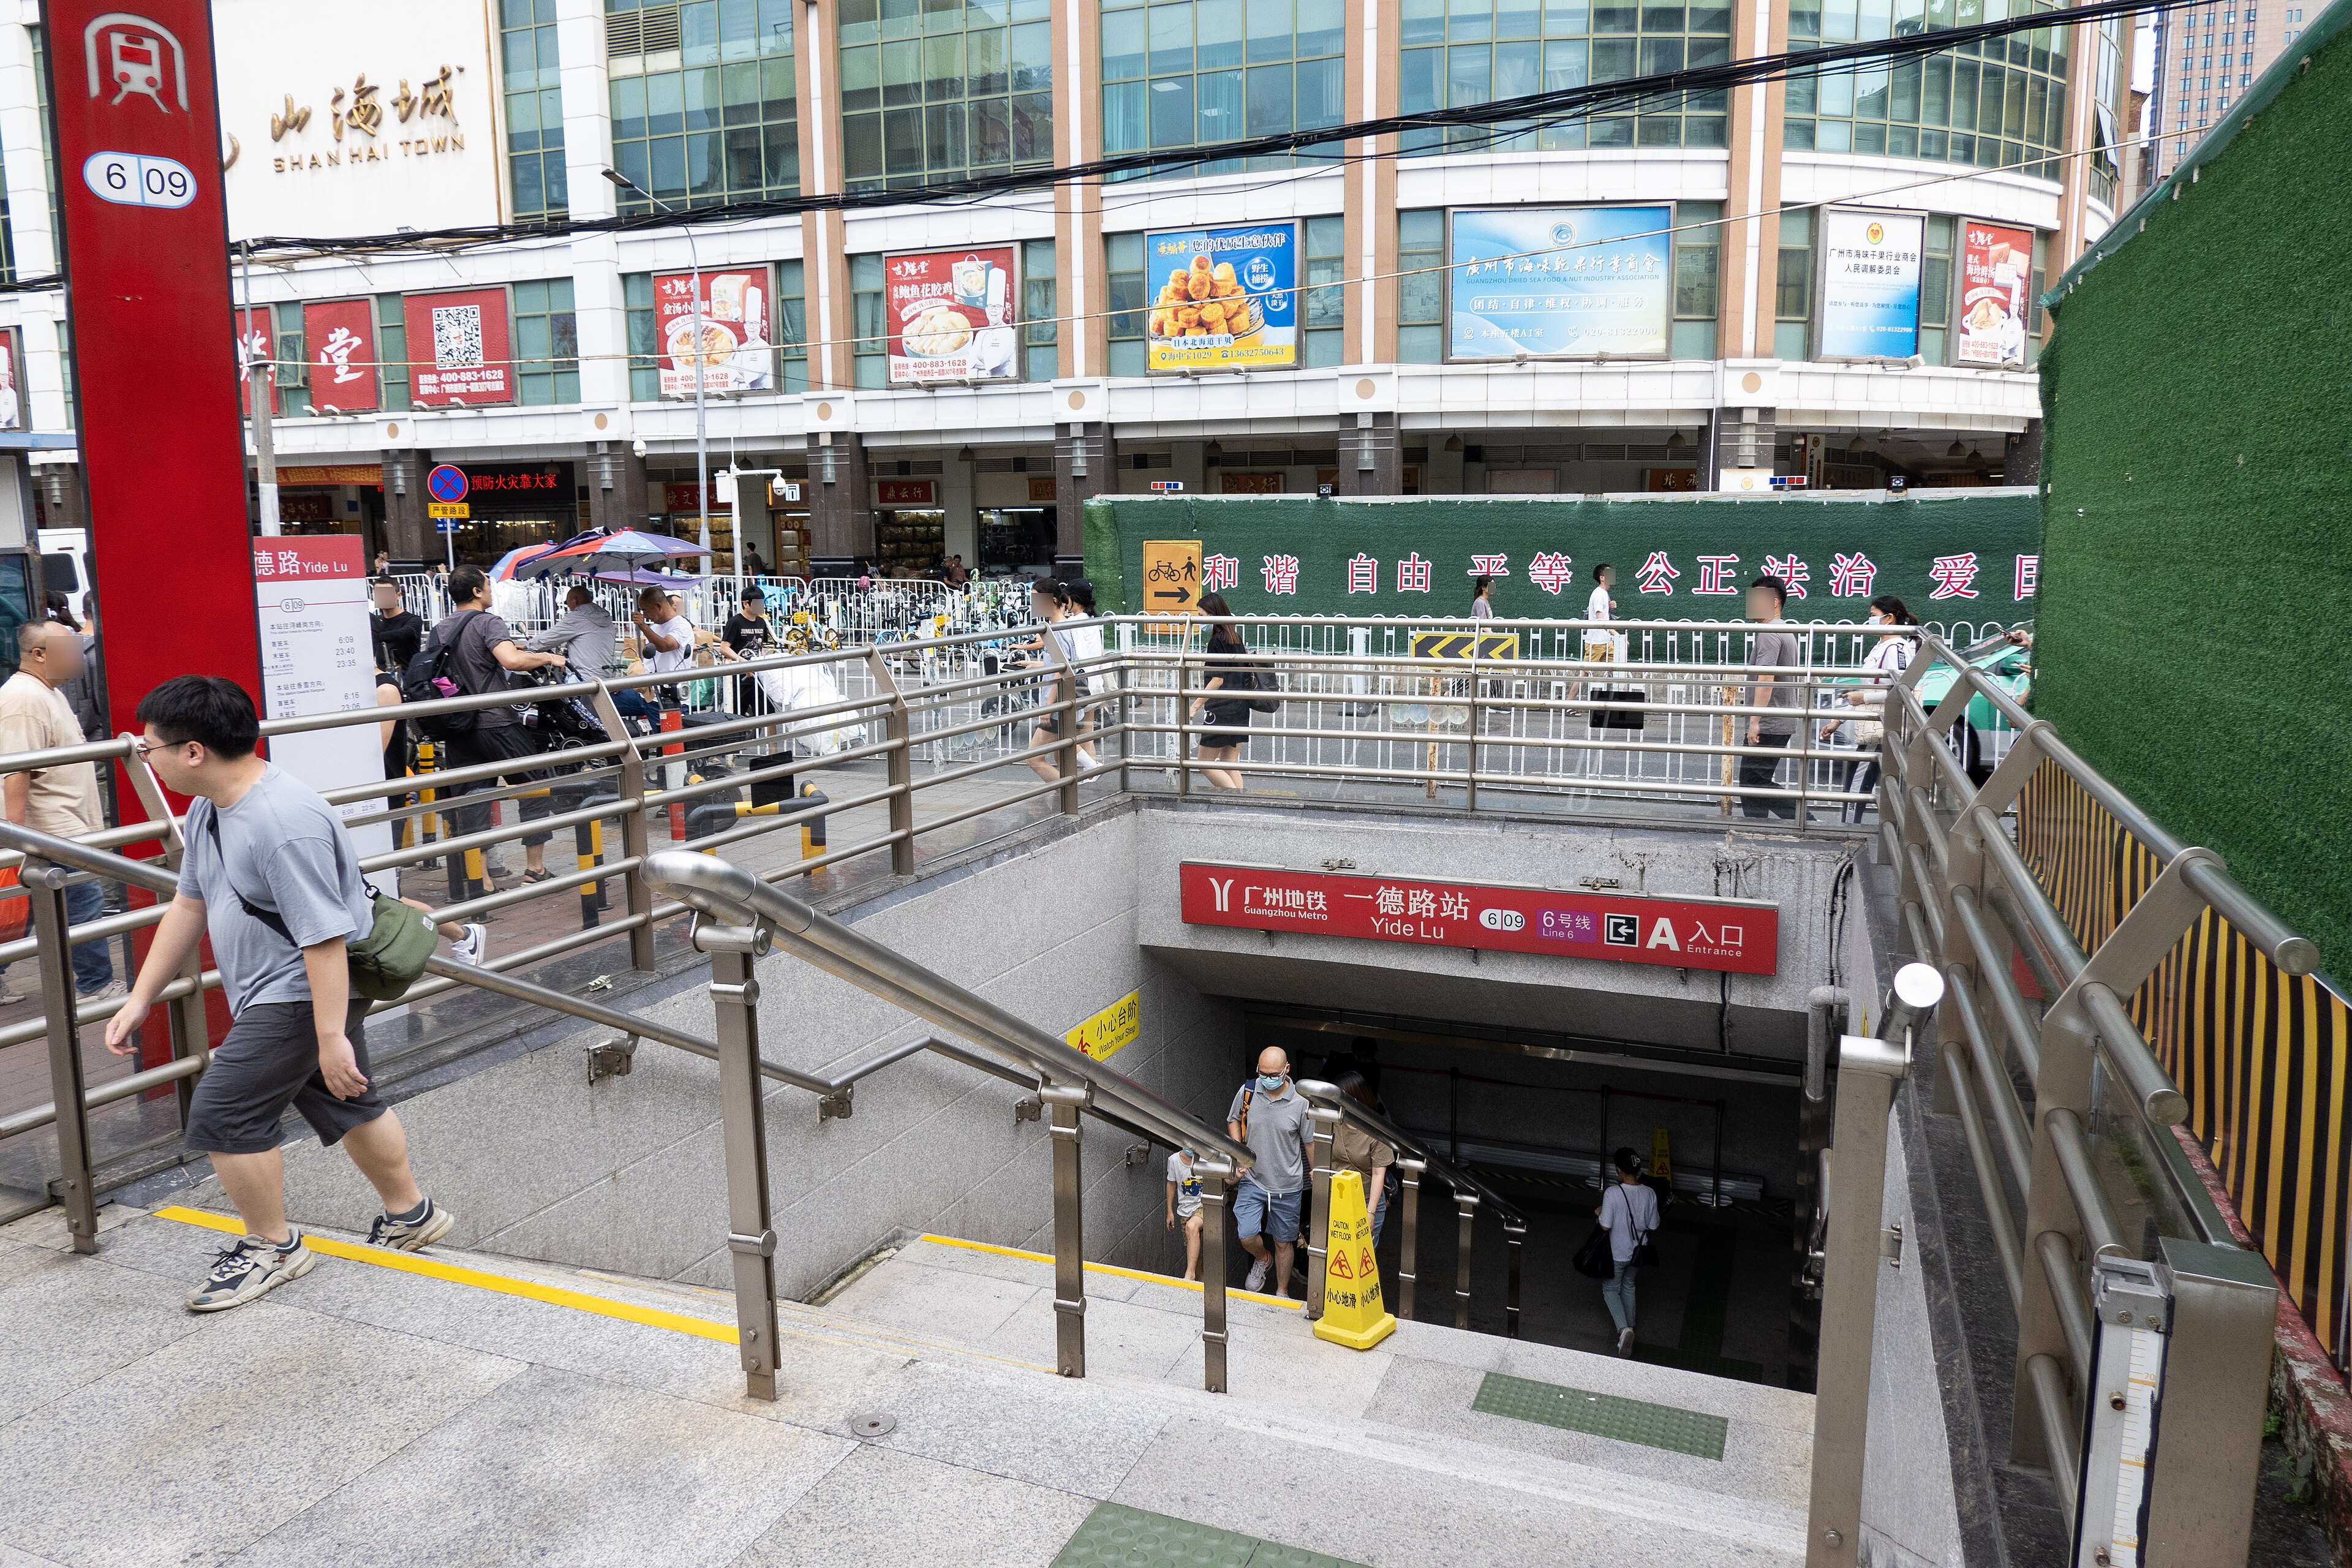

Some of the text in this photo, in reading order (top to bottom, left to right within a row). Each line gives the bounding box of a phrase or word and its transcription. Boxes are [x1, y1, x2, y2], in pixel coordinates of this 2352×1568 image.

[271, 64, 466, 141] 山海城
[274, 132, 466, 173] SHAN HAI TOWN
[106, 163, 188, 198] 6 09
[1192, 233, 1285, 252] 您的优质生意伙伴
[1968, 230, 1994, 245] 吉膳堂
[1830, 249, 1917, 262] 广州市海味干果行业商会
[891, 261, 929, 276] 吉膳堂
[1251, 263, 1268, 273] 野生
[1845, 263, 1900, 275] 人民调解委员会
[1966, 264, 1995, 278] 海珍鲜汤
[1251, 274, 1268, 284] 捕捞
[899, 282, 952, 299] 鲍鱼花胶鸡
[663, 300, 709, 315] 金汤小
[1481, 328, 1544, 339] 本座五楼A1室
[1584, 326, 1657, 337] 020-81322900
[1174, 336, 1232, 347] 日本北海道干贝
[320, 326, 364, 383] 堂
[1168, 351, 1212, 361] 海中宝1029
[1230, 348, 1284, 358] 13632750643
[913, 360, 967, 368] 400-883-1628
[440, 369, 503, 383] 400-883-1628
[680, 373, 728, 382] 400-3-1628
[470, 473, 557, 491] 预防火灾靠大家
[887, 486, 923, 500] 鼎云行
[432, 506, 466, 516] 严管路段
[302, 560, 348, 573] Yide Lu
[1202, 553, 1300, 595] 和谐
[1348, 551, 1433, 595] 自由
[1467, 551, 1572, 595] 平等
[1635, 551, 1740, 597] 公正
[1761, 552, 1877, 600] 法治
[336, 647, 355, 656] 23:40
[337, 660, 356, 668] 23:35
[362, 804, 376, 812] 22:50
[1243, 885, 1328, 912] 广州地铁
[1343, 884, 1471, 921] 一德路站
[1244, 905, 1328, 921] Guangzhou Metro
[1488, 913, 1525, 928] 6 09
[1542, 911, 1591, 930] 6号线
[1370, 916, 1444, 940] Yide Lu
[1542, 927, 1574, 939] Line 6
[1646, 917, 1681, 951] A
[1687, 920, 1743, 948] 入口
[1687, 944, 1742, 957] Entrance
[1096, 999, 1137, 1041] 小心台阶
[1098, 1024, 1136, 1055] Watch Your Step
[1333, 1219, 1349, 1231] CAUTION
[1356, 1217, 1367, 1229] CAUTION
[1330, 1229, 1352, 1242] WET FLOOR
[1327, 1287, 1357, 1309] 小心地滑
[1361, 1282, 1380, 1308] 小心地滑
[2144, 1373, 2156, 1381] 70
